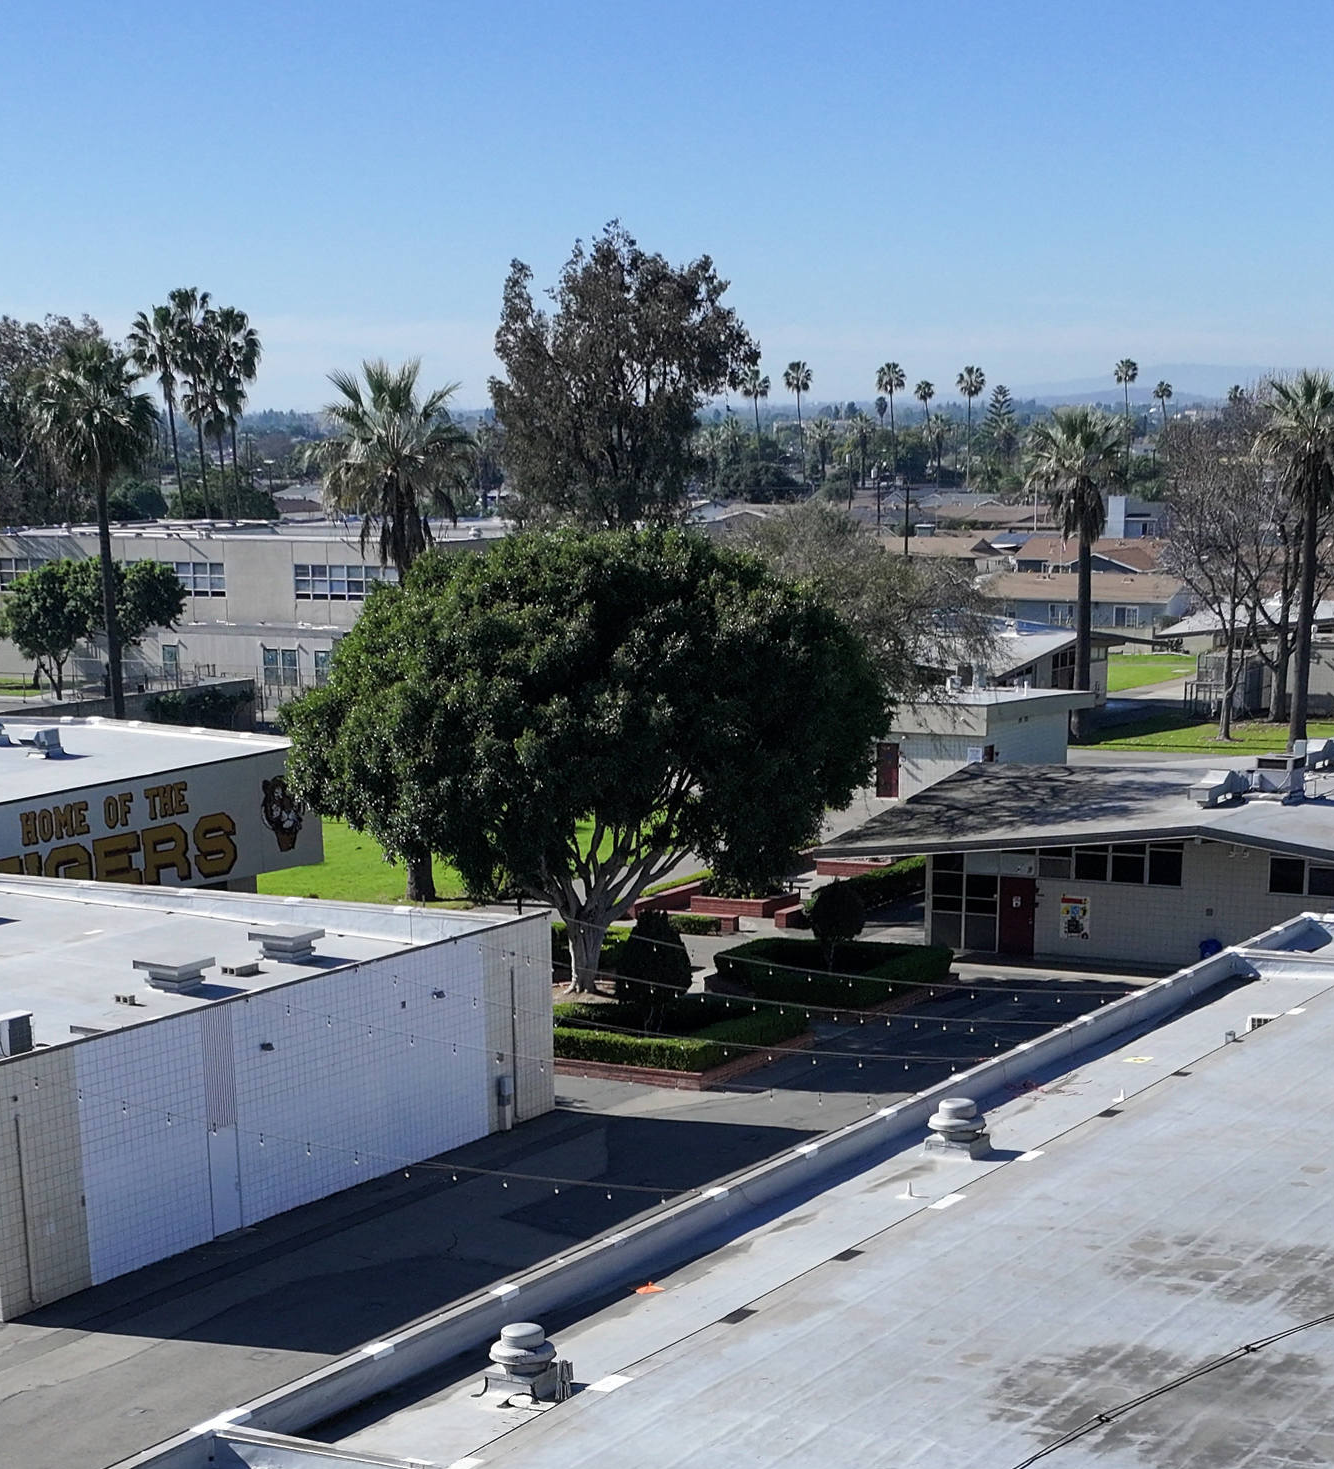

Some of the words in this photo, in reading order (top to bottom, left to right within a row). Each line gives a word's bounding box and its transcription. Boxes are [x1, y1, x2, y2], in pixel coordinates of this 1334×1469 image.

[20, 801, 90, 846] HOME
[103, 792, 134, 829] OF
[144, 781, 189, 820] THE
